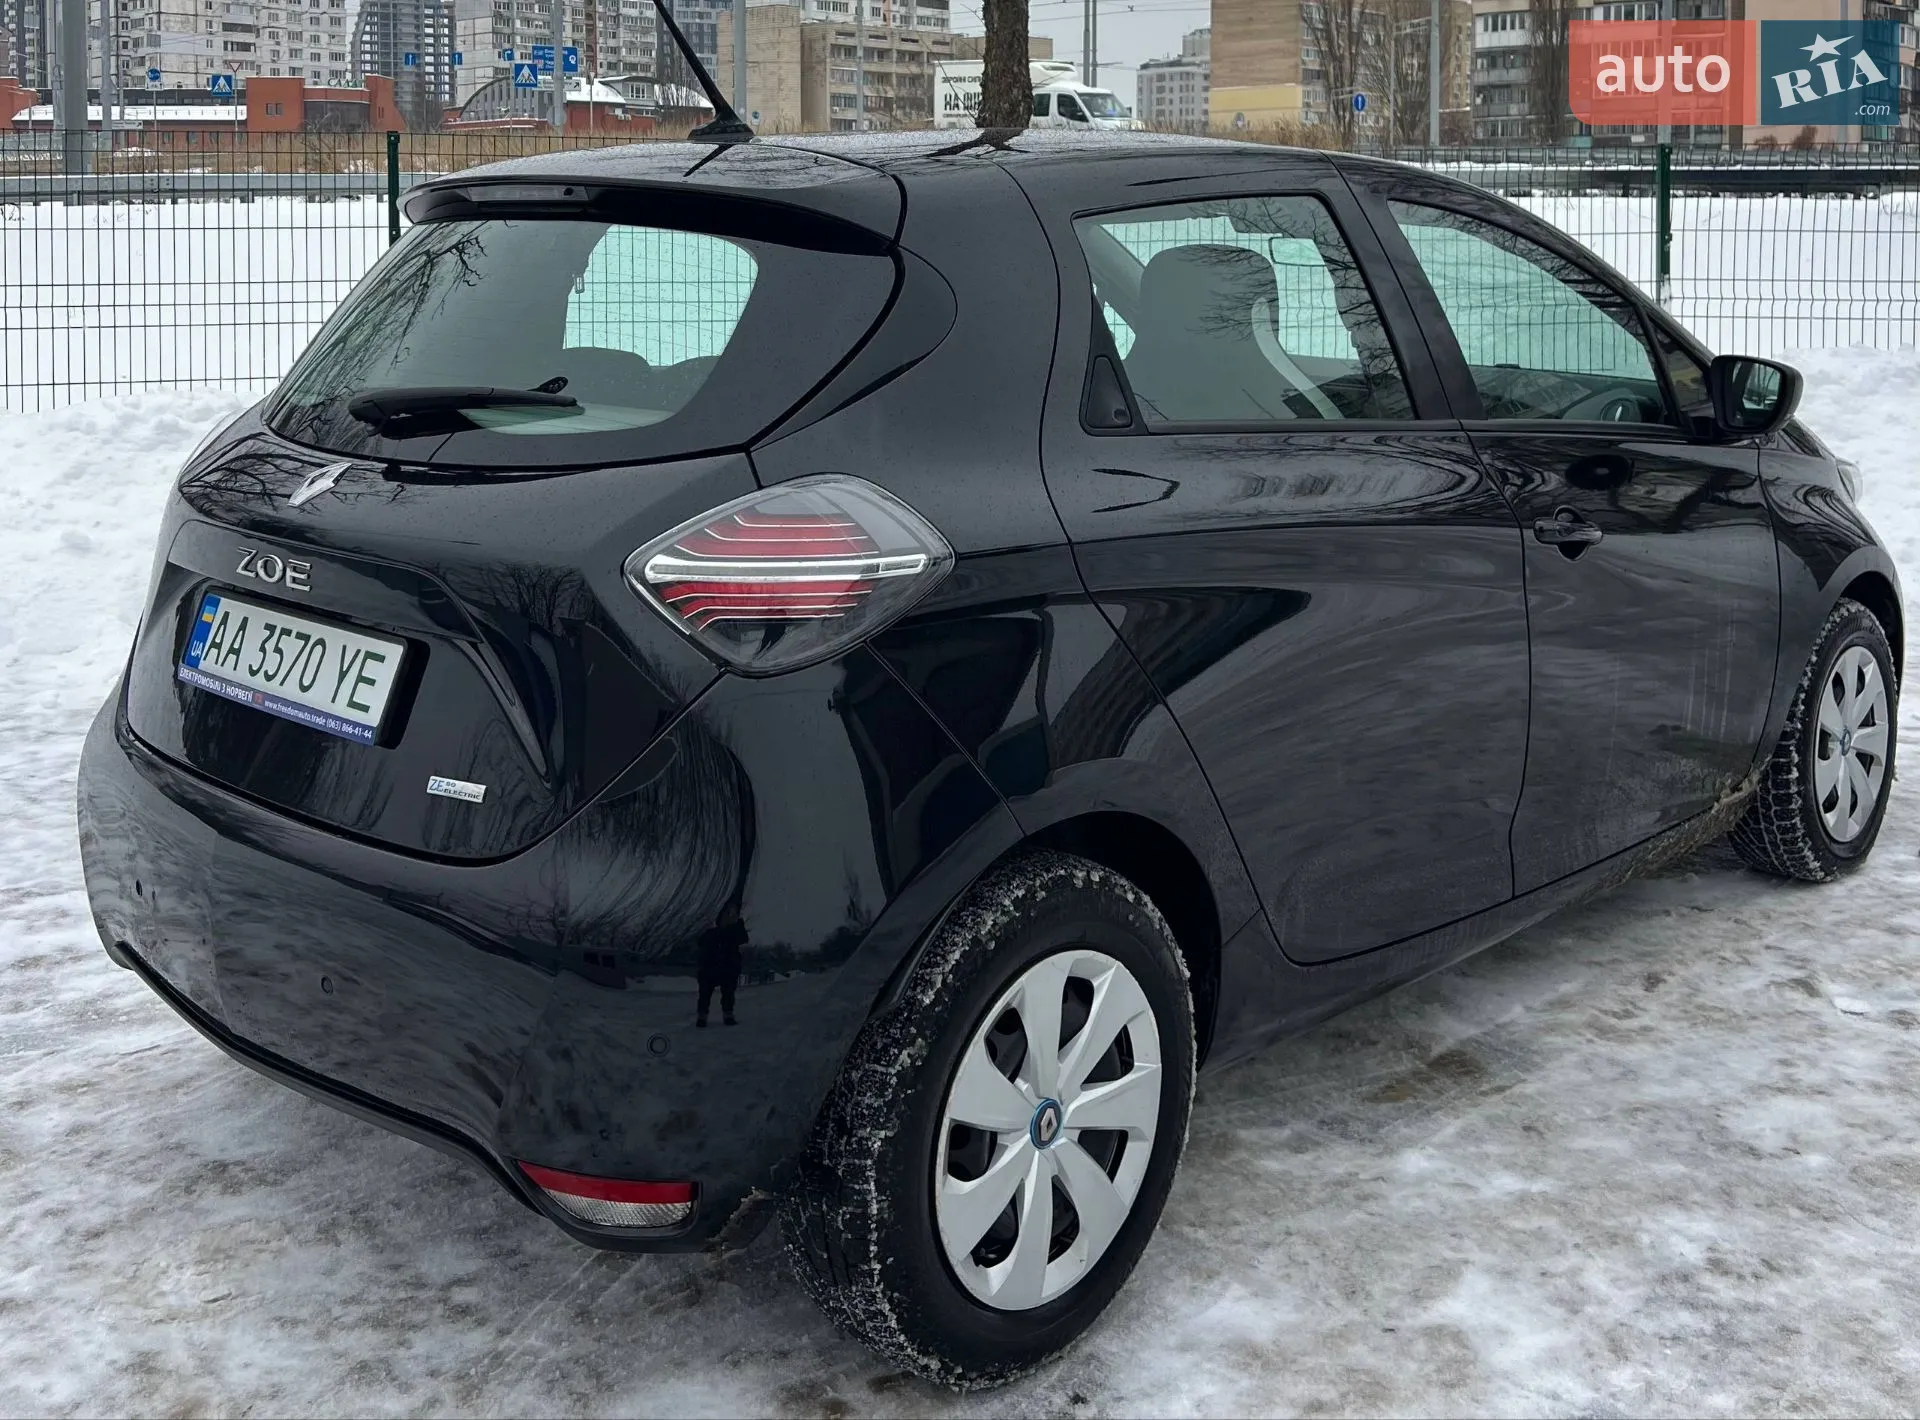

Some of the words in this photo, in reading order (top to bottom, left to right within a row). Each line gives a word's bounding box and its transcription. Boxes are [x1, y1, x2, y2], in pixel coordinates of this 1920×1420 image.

[235, 547, 312, 592] ZOE
[190, 640, 204, 658] UA
[203, 610, 249, 671] AA
[248, 623, 327, 693] 3570
[331, 644, 386, 713] YE
[326, 718, 342, 732] (063)
[444, 788, 481, 800] ELECTRIC
